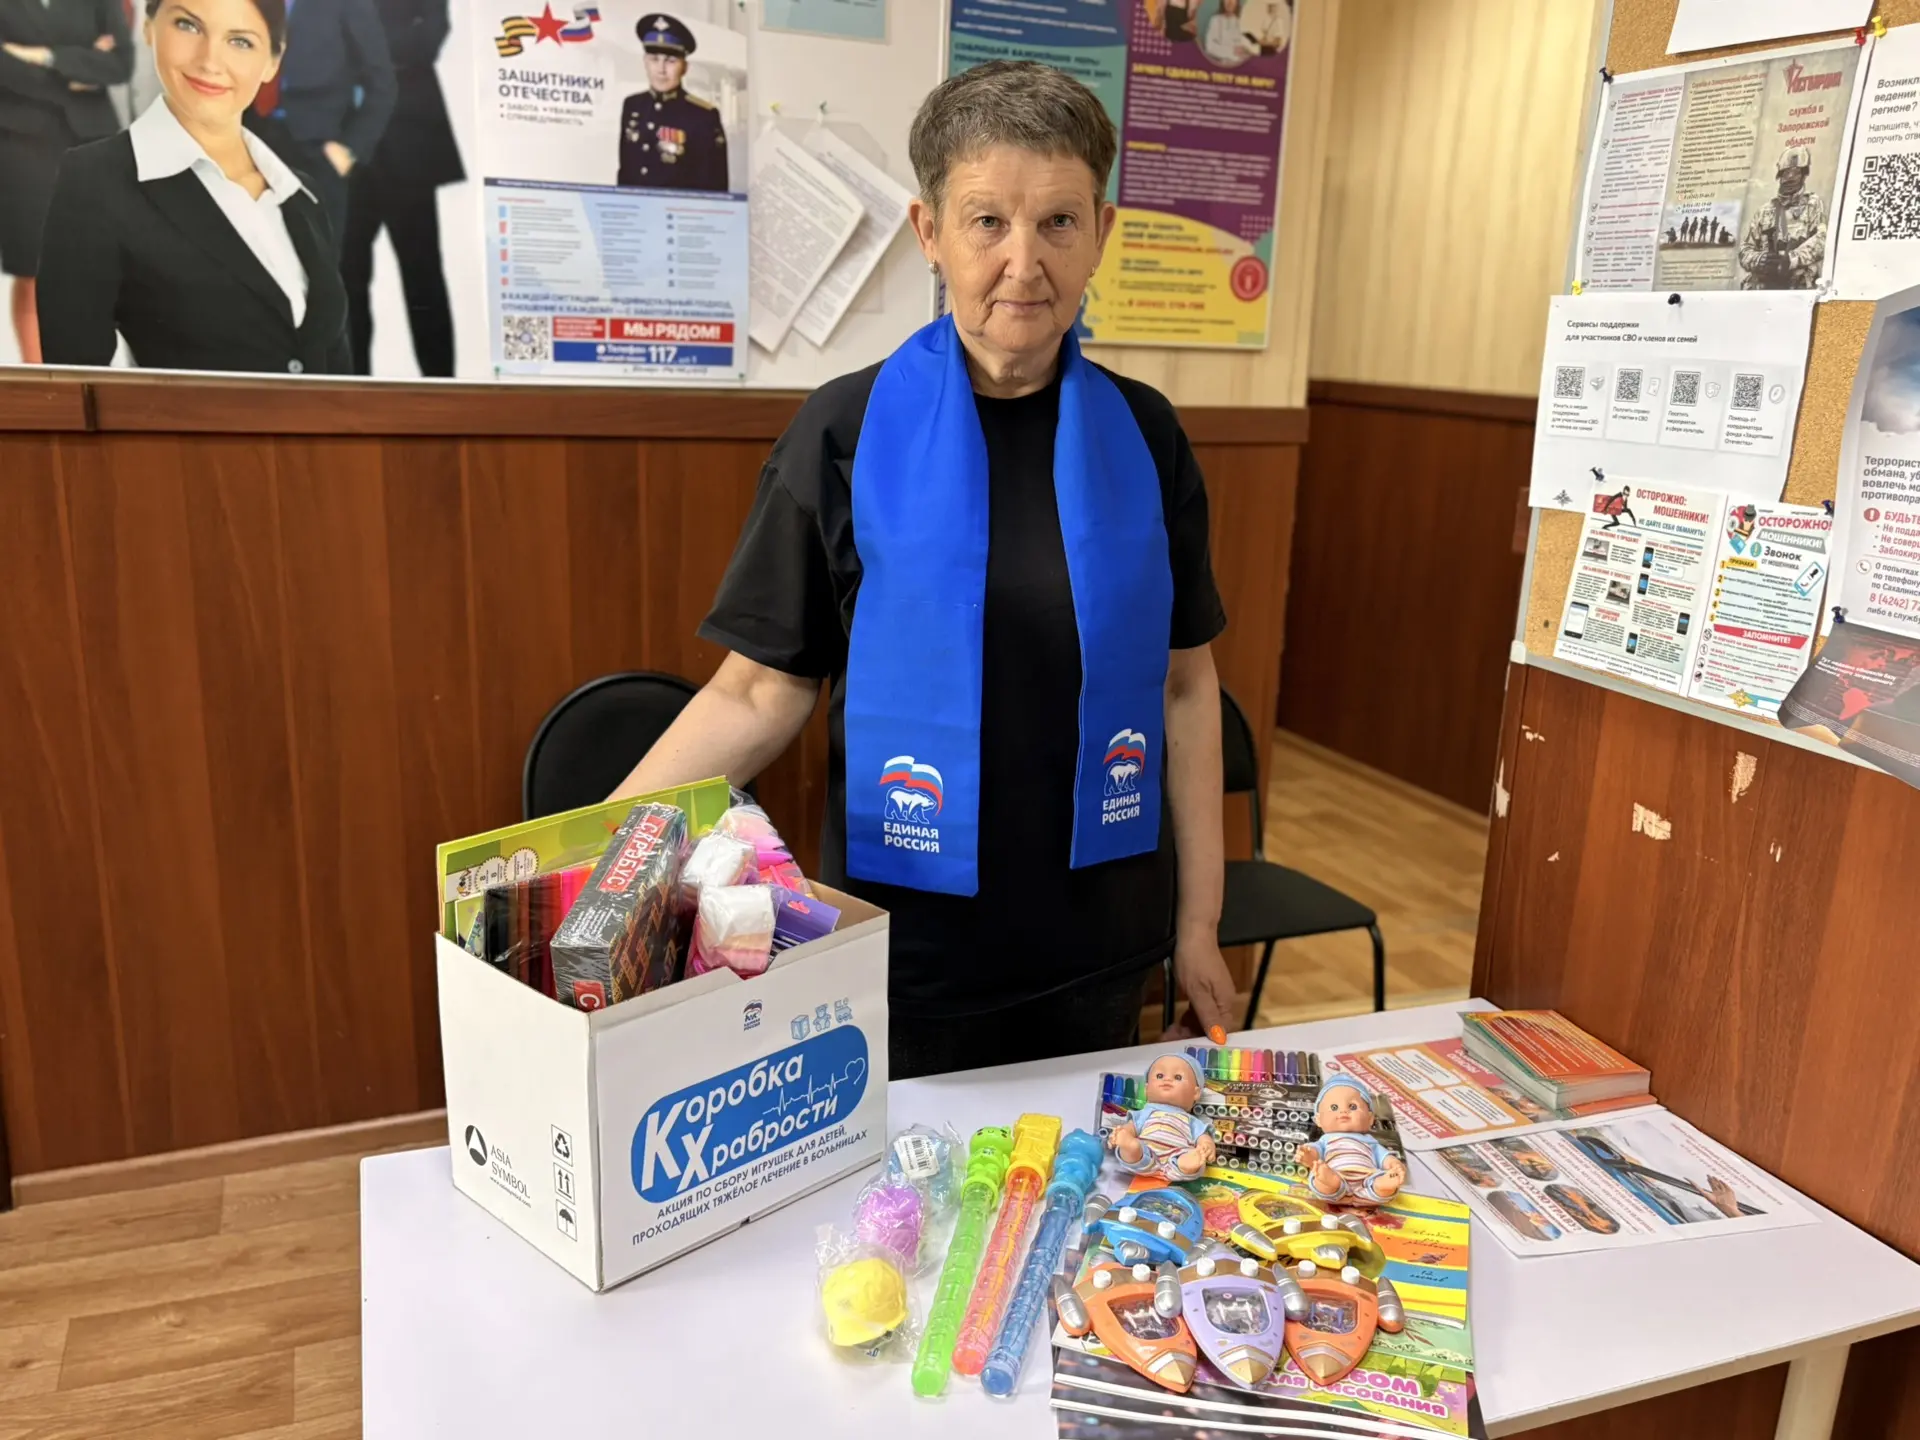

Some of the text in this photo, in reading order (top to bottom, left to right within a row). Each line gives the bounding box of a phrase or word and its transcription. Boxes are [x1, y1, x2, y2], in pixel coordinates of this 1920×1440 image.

[498, 68, 604, 90] ЗАЩИТНИКИ
[498, 84, 593, 105] ОТЕЧЕСТВА
[1874, 90, 1916, 103] ведении
[1789, 104, 1817, 118] служба
[1870, 101, 1918, 118] регионе?
[1777, 116, 1830, 133] Запорожской
[1869, 122, 1912, 132] Напишите,
[1785, 136, 1816, 149] области
[1867, 134, 1903, 144] получить
[623, 321, 653, 337] МЫ
[655, 323, 721, 341] РЯДОМ!
[1567, 320, 1639, 329] Сервисы поддержки
[1581, 334, 1621, 342] участников
[1622, 334, 1637, 342] СВО
[1676, 335, 1698, 343] семей
[649, 346, 678, 363] 117
[1863, 467, 1907, 480] обмана,
[1862, 480, 1907, 490] вовлечь
[1636, 488, 1687, 506] ОСТОРОЖНО:
[1653, 505, 1710, 524] МОШЕННИКИ!
[1645, 519, 1661, 528] ДАЙТЕ
[1662, 522, 1675, 531] СЕБЯ
[1676, 525, 1706, 537] ОБМАНУТЬ!
[1758, 516, 1832, 531] ОСТОРОЖНО!
[1883, 524, 1893, 532] Не
[1760, 530, 1823, 548] МОШЕННИКИ!
[1881, 534, 1891, 543] Не
[1764, 546, 1802, 561] Звонок
[1882, 565, 1919, 576] попытках
[1884, 574, 1920, 588] телефону
[1869, 592, 1876, 602] 8
[1878, 593, 1909, 610] (4242)
[1866, 607, 1886, 615] либо
[1742, 630, 1791, 644] ЗАПОМНИТЕ!
[1103, 792, 1141, 811] ЕДИНАЯ
[1102, 805, 1140, 825] РОССИЯ
[883, 822, 939, 839] ЕДИНАЯ
[884, 835, 940, 853] РОССИЯ
[641, 1053, 804, 1191] Коробка
[1399, 1101, 1446, 1133] ЗВОНИТЕ
[676, 1094, 839, 1193] Храбрости
[491, 1144, 513, 1169] ASIA
[491, 1161, 531, 1199] SYMBOL
[656, 1124, 847, 1220] АКЦИЯ ПО СБОРУ ИГРУШЕК ДЛЯ ДЕТЕЙ,
[632, 1203, 710, 1246] ПРОХОДЯЩИХ
[712, 1178, 758, 1209] ТЯЖЁЛОЕ
[760, 1158, 802, 1186] ЛЕЧЕНИЕ
[803, 1155, 809, 1166] В
[810, 1129, 868, 1163] БОЛЬНИЦАХ
[1517, 1175, 1551, 1204] СУХУЮ
